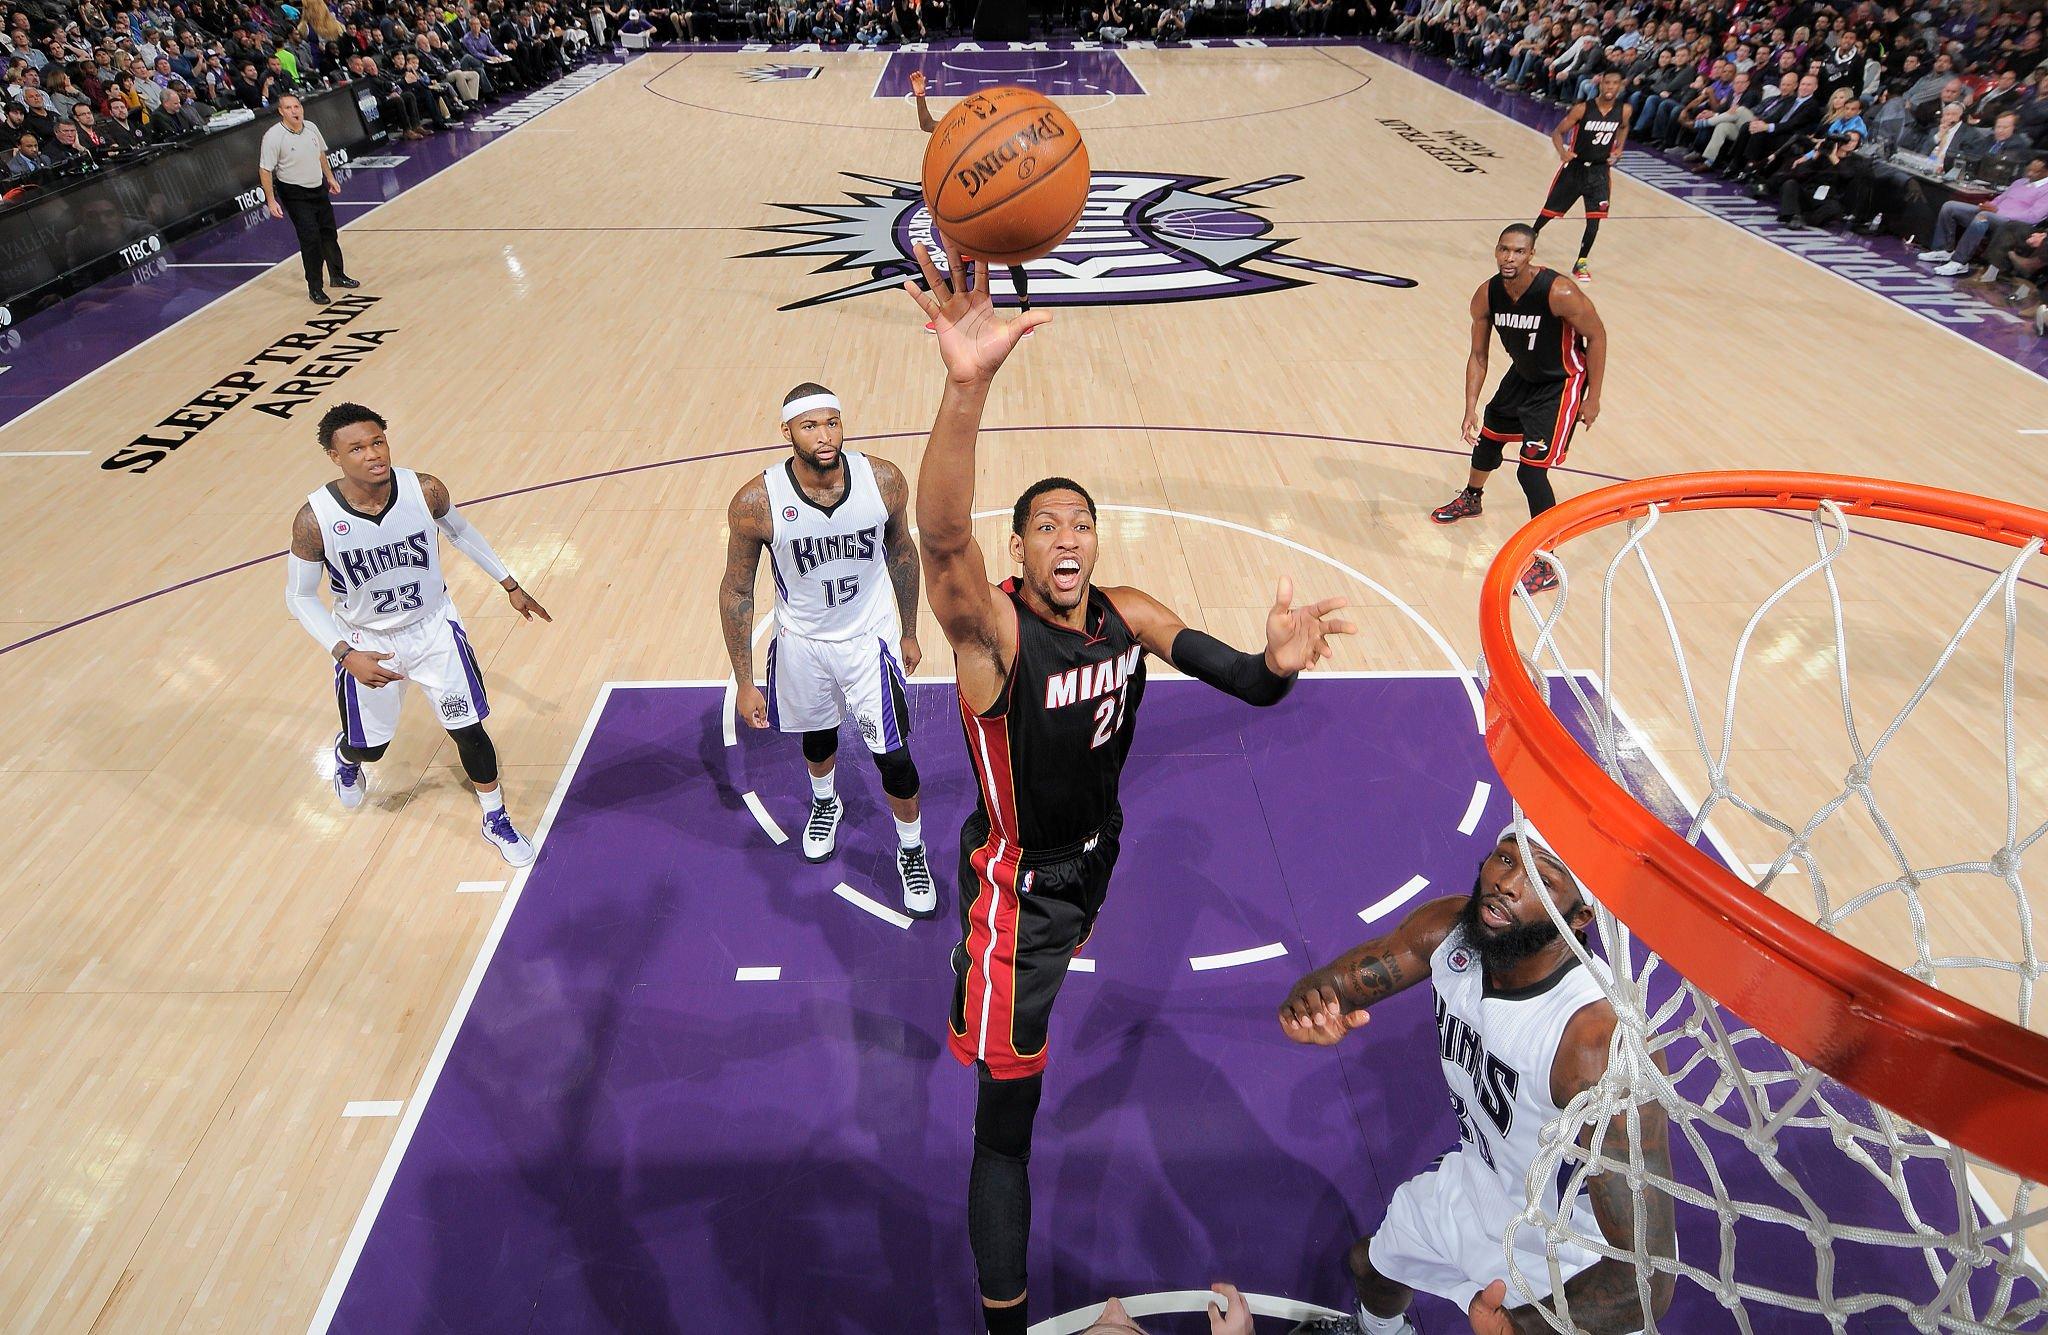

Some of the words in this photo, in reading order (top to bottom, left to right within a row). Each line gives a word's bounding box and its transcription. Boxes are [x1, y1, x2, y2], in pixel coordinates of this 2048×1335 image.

[1375, 118, 1437, 142] TRAIN
[1584, 120, 1620, 131] MIAMI
[1592, 132, 1613, 145] 30
[955, 113, 1064, 199] SPALDING
[1417, 144, 1487, 174] SLEEP
[1432, 130, 1504, 158] ARENA
[235, 187, 265, 211] TIBCO
[119, 235, 161, 266] TIBCO
[1683, 196, 2026, 323] SACRAMENTO
[1494, 313, 1541, 329] MIAMI
[1528, 332, 1537, 350] 1
[100, 371, 267, 473] SLEEP
[243, 294, 383, 366] TRAIN
[251, 329, 399, 419] ARENA
[339, 530, 430, 590] KINGS
[790, 525, 878, 577] KINGS
[371, 581, 424, 614] 23
[821, 575, 860, 608] 15
[441, 701, 468, 716] KINGS
